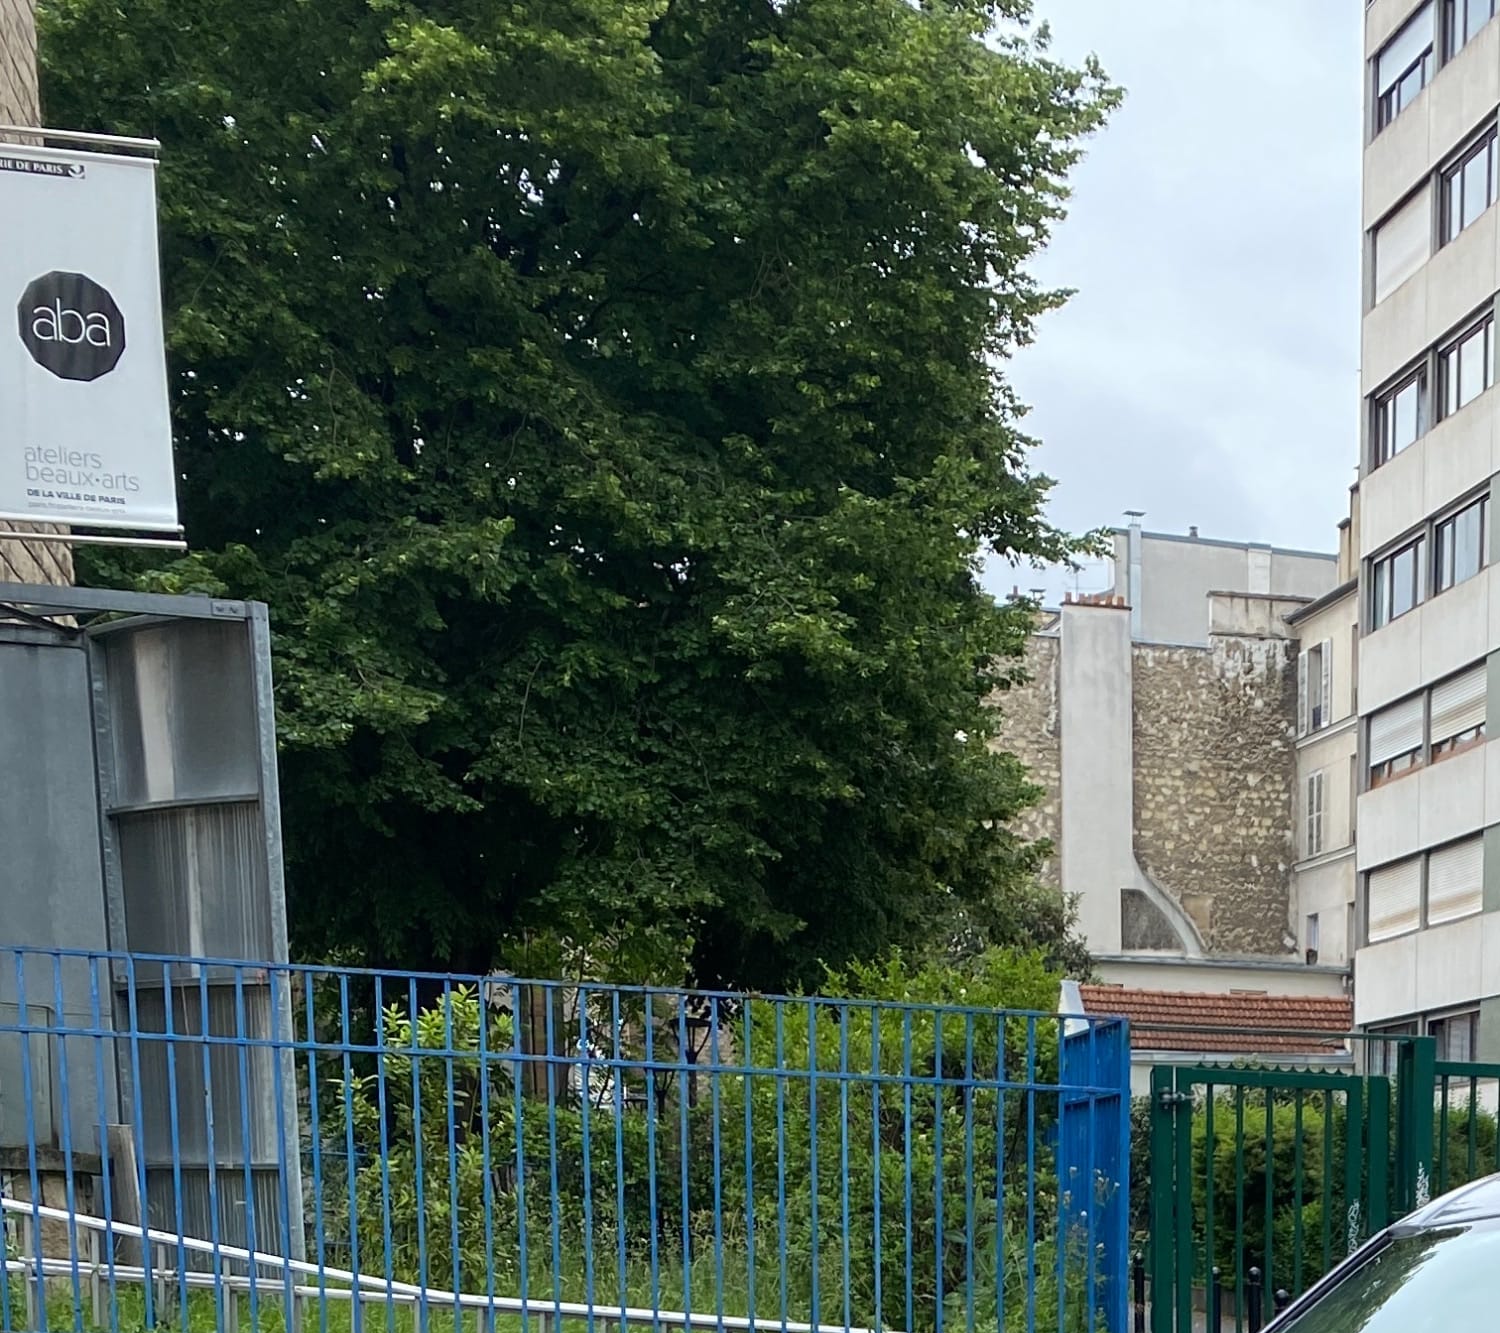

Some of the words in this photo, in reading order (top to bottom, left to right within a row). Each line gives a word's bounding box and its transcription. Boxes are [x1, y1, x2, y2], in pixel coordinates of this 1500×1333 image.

[16, 161, 32, 171] DE
[33, 162, 63, 174] PARIS
[32, 298, 111, 347] aba
[24, 445, 102, 469] ateliers
[27, 488, 40, 497] DE
[42, 490, 55, 498] LA
[56, 491, 82, 501] VILLE
[83, 494, 96, 502] DE
[98, 496, 126, 505] PARIS
